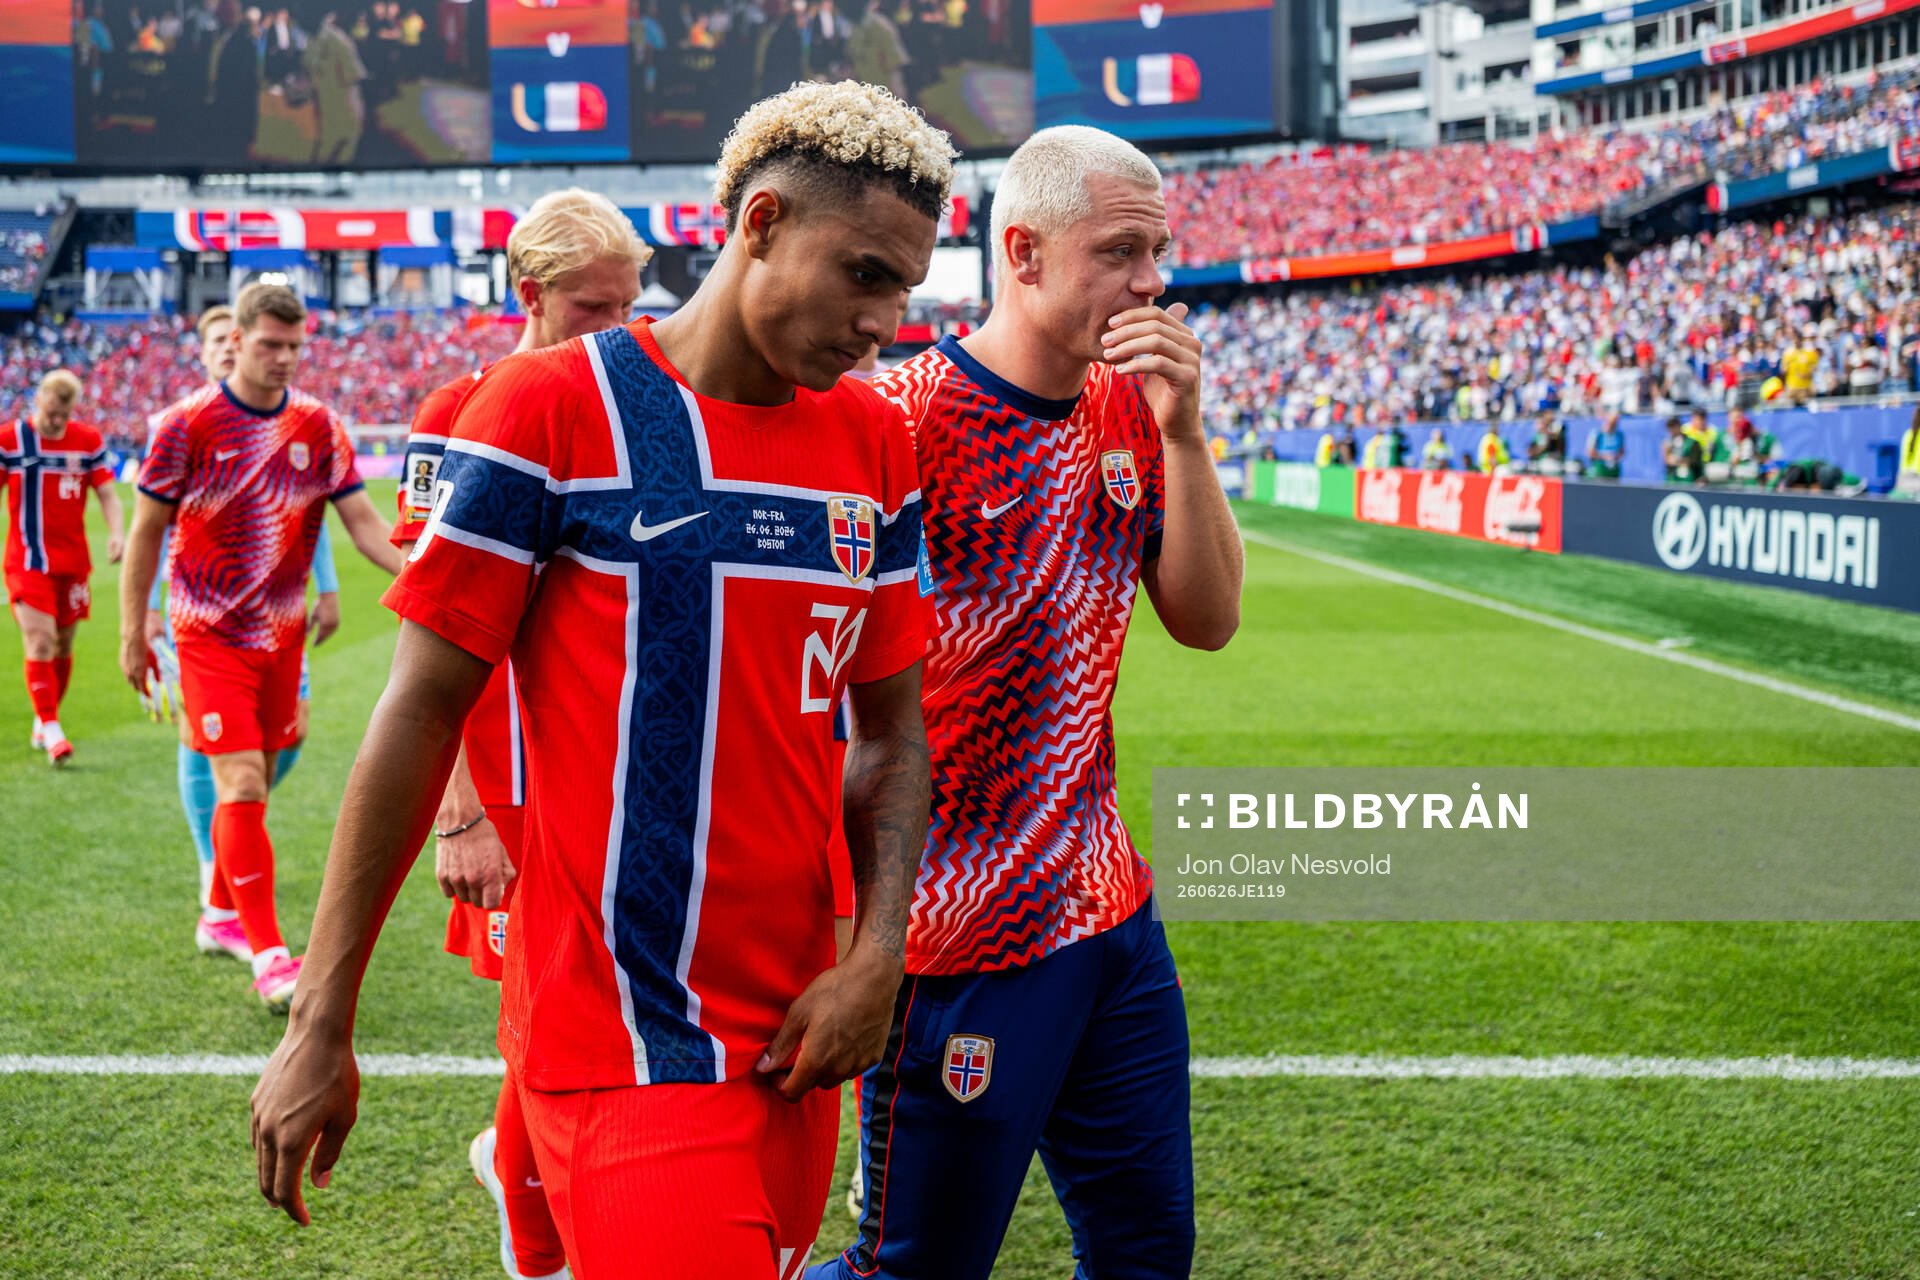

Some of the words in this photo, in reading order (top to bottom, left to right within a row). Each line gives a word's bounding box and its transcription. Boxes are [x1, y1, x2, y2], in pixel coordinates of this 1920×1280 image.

[752, 509, 785, 521] NOR-FRA
[757, 538, 785, 550] BOSTON
[1708, 504, 1880, 589] HYUNDAI
